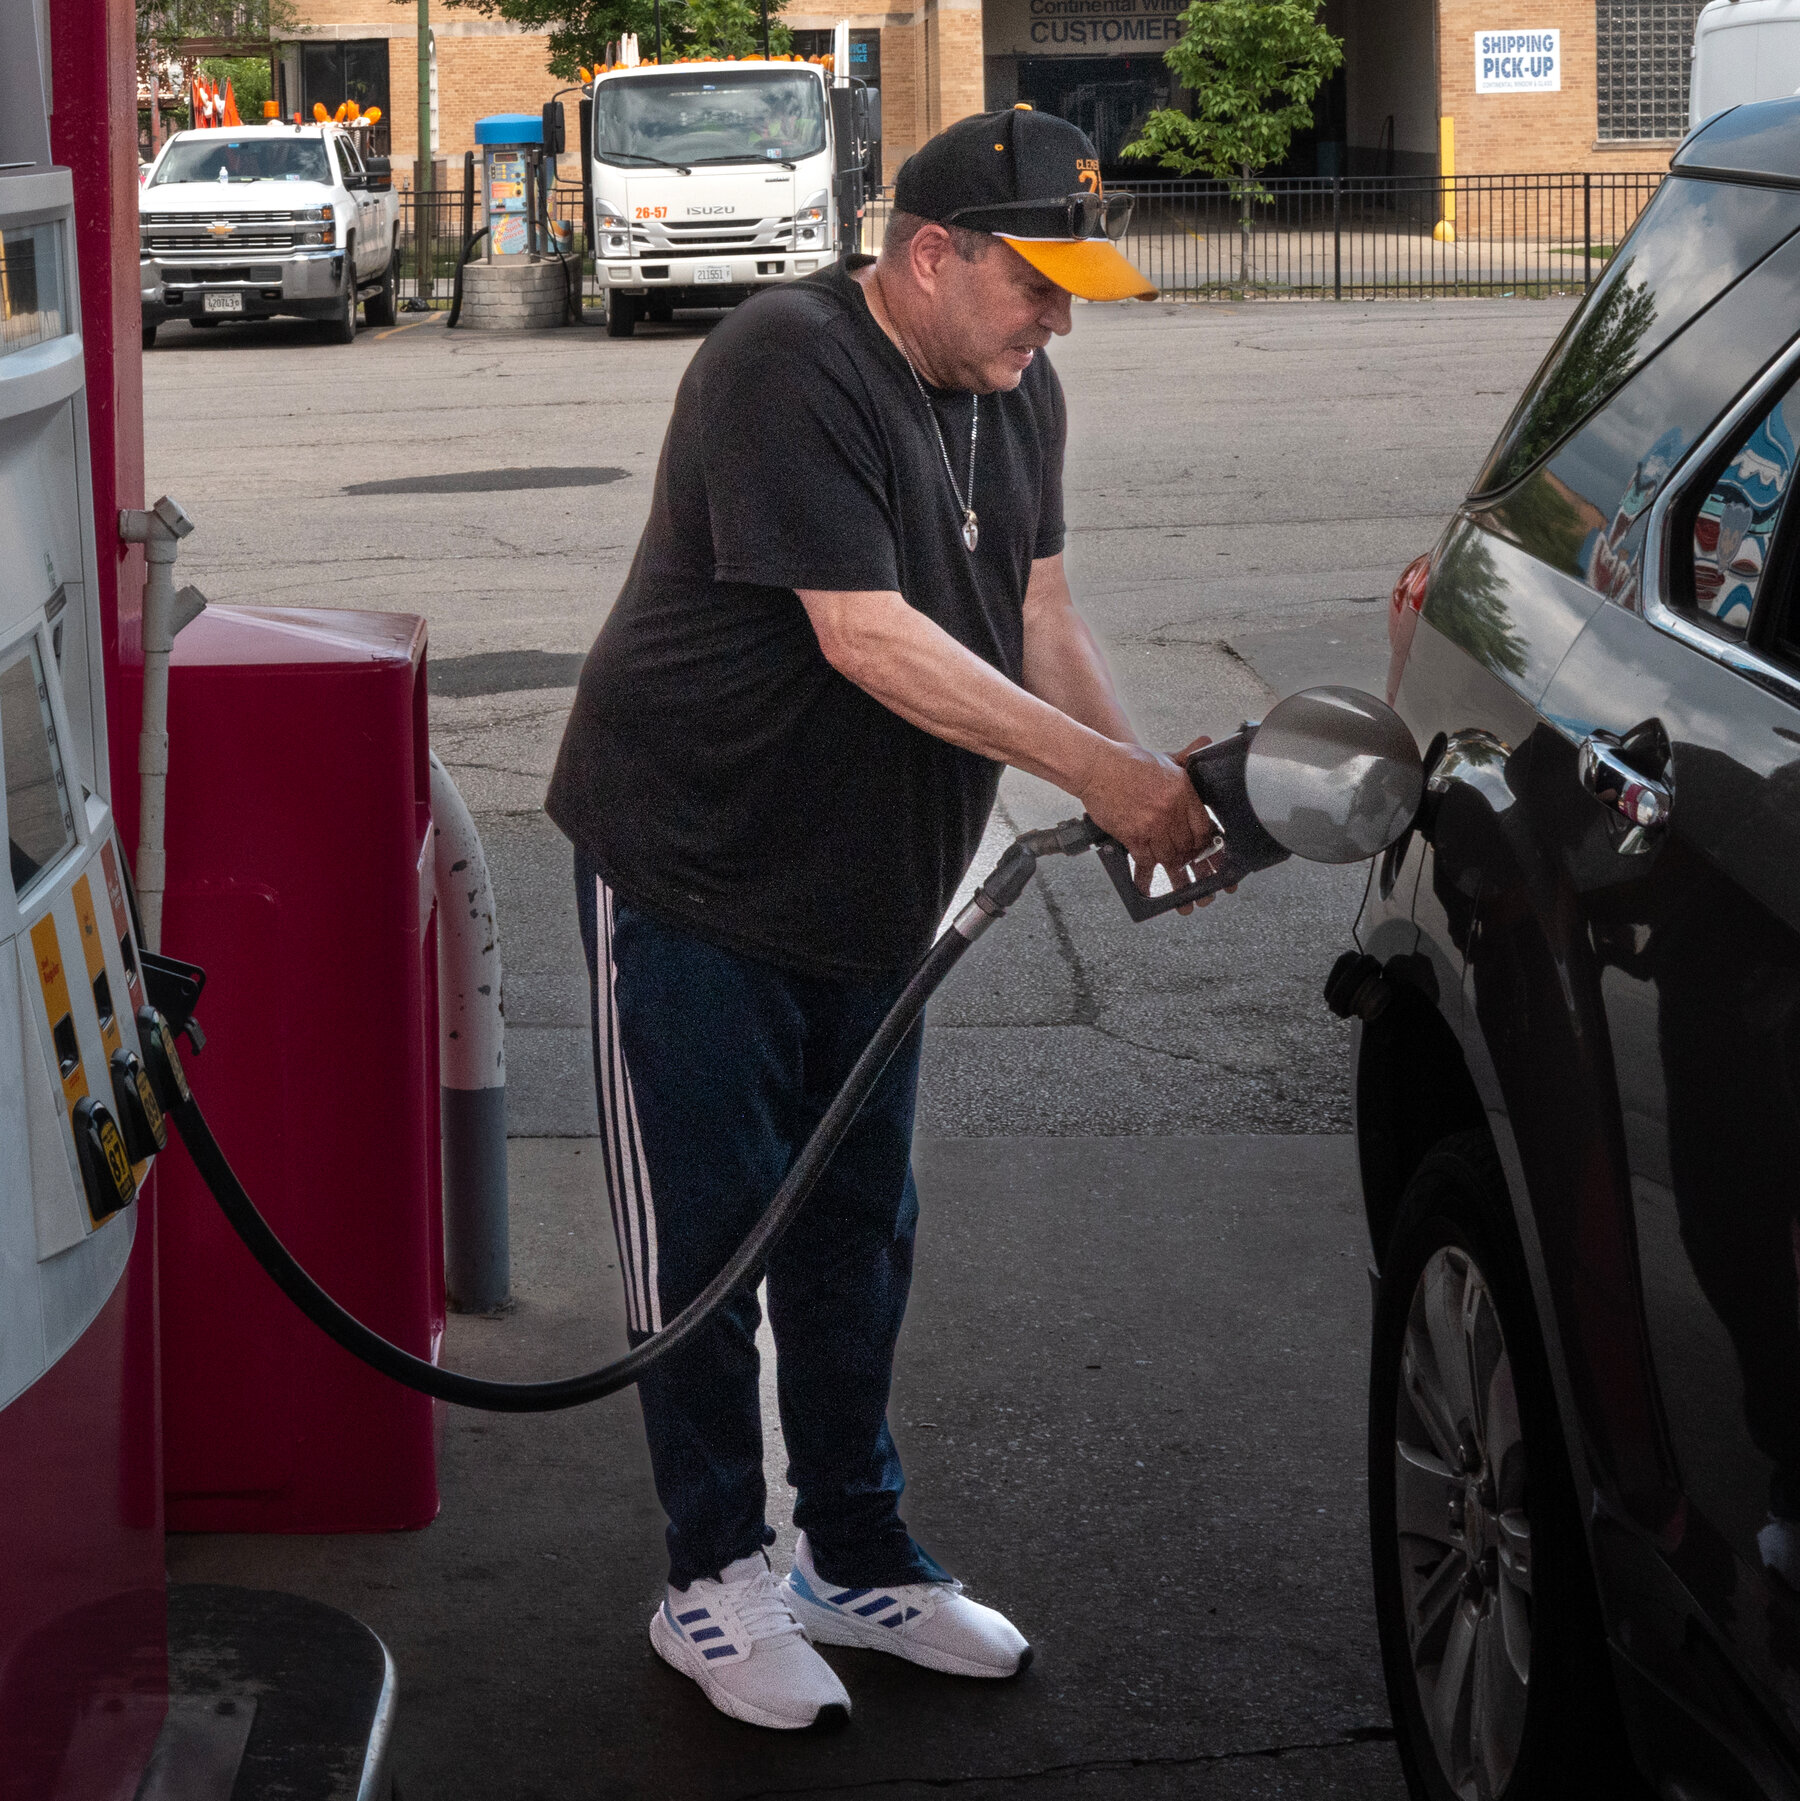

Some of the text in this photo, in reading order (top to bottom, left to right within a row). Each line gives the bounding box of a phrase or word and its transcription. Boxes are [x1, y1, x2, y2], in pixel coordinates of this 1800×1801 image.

[1030, 0, 1190, 14] Continental Wind
[1030, 19, 1181, 43] CUSTOMER
[1482, 34, 1554, 54] SHIPPING
[1483, 56, 1554, 79] PICK-UP
[635, 206, 668, 219] 26-57
[686, 206, 735, 216] ISUZU
[697, 269, 723, 280] 211551
[108, 1142, 127, 1182] 87
